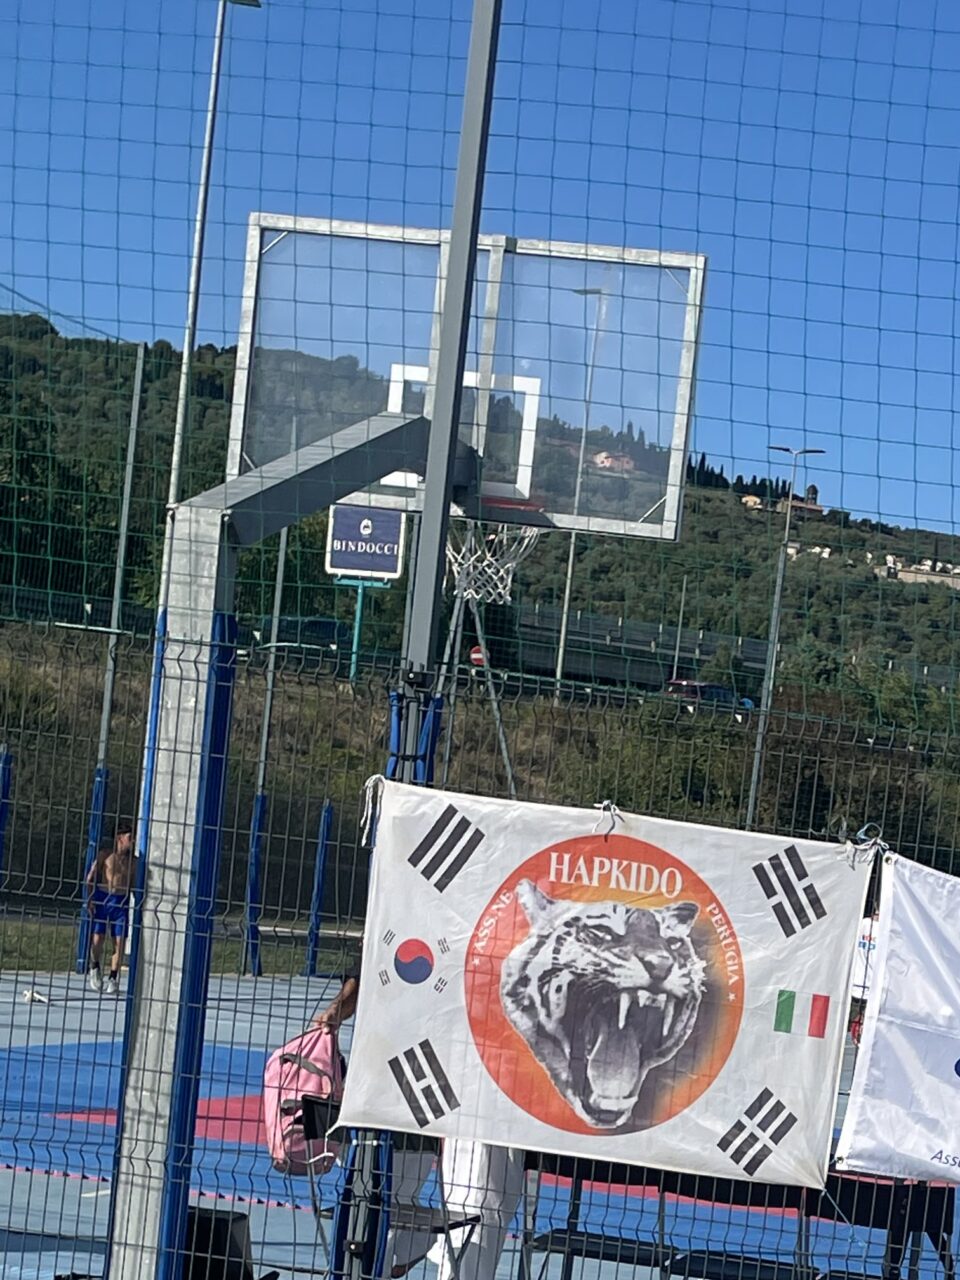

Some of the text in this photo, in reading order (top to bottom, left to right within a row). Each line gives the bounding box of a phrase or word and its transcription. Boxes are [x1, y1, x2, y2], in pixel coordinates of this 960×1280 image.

[333, 539, 398, 555] BINDOCCI
[548, 851, 683, 898] HAPKIDO
[706, 902, 740, 986] PERUGIA
